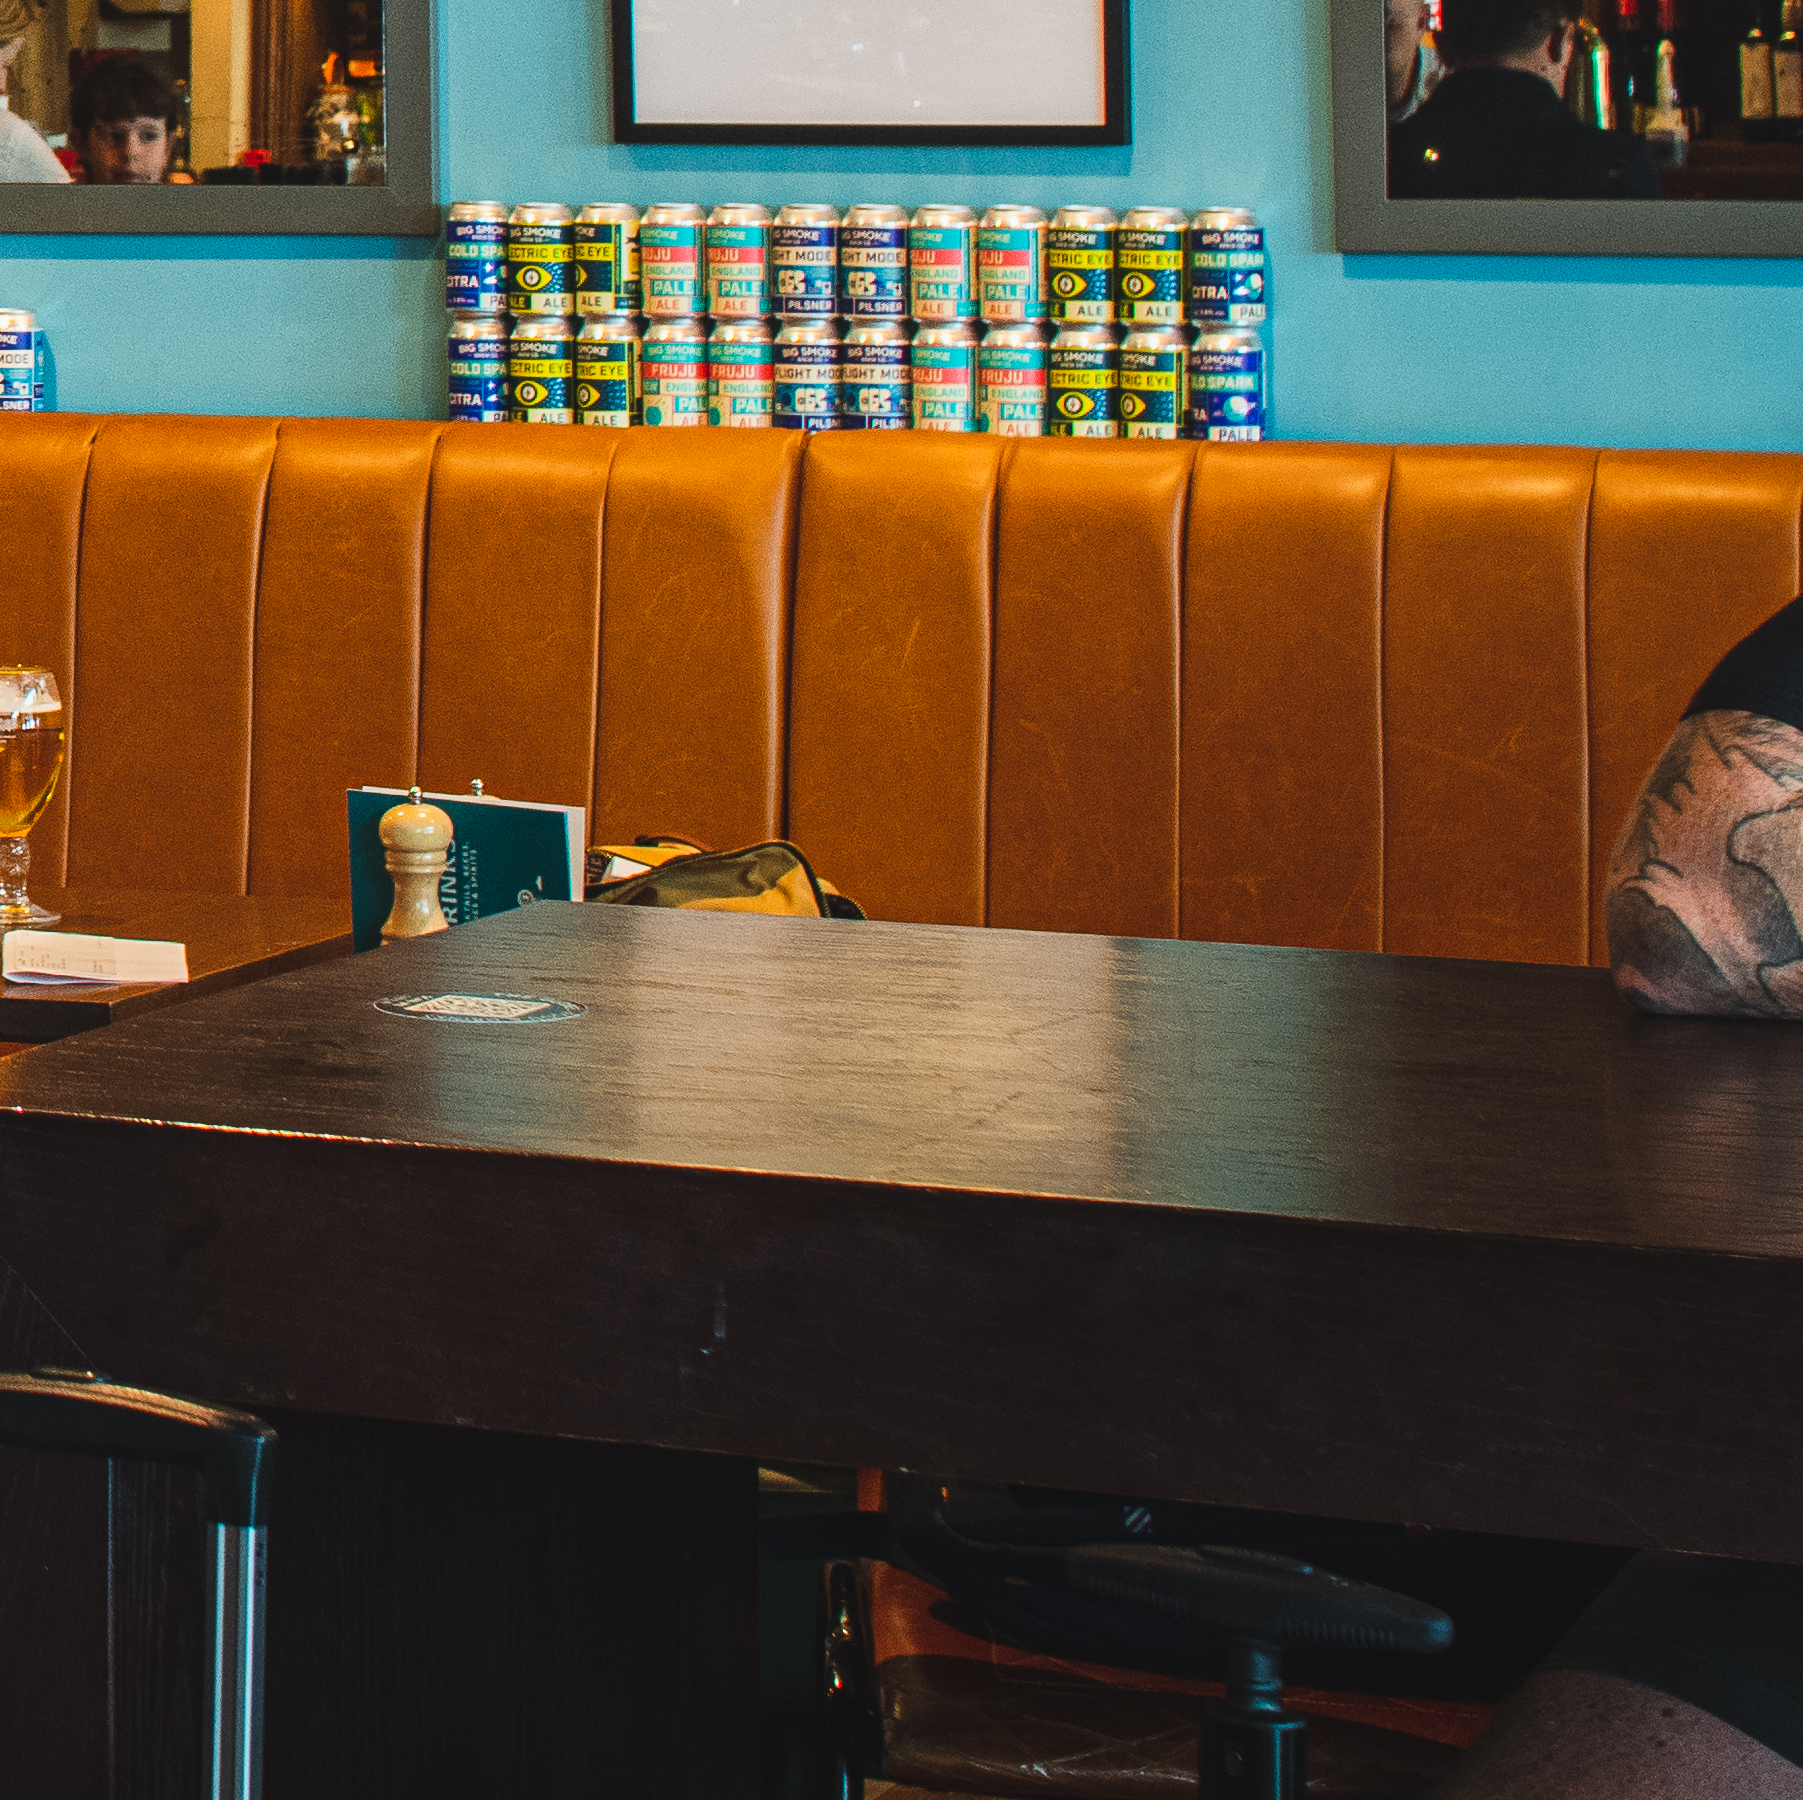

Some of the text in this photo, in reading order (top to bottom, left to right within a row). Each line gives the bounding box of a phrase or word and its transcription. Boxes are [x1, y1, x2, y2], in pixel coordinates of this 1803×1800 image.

[522, 227, 562, 239] SMOKE
[552, 248, 574, 260] EYE
[588, 245, 611, 258] EYE
[795, 250, 832, 262] MODE
[866, 252, 903, 264] MODE
[1086, 254, 1112, 266] EYE
[1156, 254, 1181, 266] EYE
[653, 280, 694, 295] PALE
[721, 281, 761, 295] PALE
[919, 285, 958, 298] PALE
[987, 285, 1026, 299] PALE
[543, 296, 567, 308] ALE
[581, 295, 602, 307] ALE
[656, 299, 680, 310] ALE
[723, 300, 748, 311] ALE
[921, 302, 944, 314] ALE
[989, 303, 1012, 315] ALE
[1077, 305, 1103, 317] ALE
[1146, 305, 1172, 317] ALE
[521, 342, 558, 354] SMOKE
[1063, 352, 1104, 364] SMOKE
[549, 362, 571, 375] EYE
[600, 364, 625, 376] EYE
[651, 364, 697, 377] FRUJU
[712, 365, 755, 378] FRUJU
[1146, 376, 1171, 388] EYE
[1208, 375, 1254, 389] SPARK
[925, 402, 966, 417] PALE
[540, 413, 565, 424] ALE
[593, 415, 617, 426] ALE
[1006, 424, 1031, 436] ALE
[1086, 424, 1113, 436] ALE
[1138, 427, 1162, 439] ALE
[1218, 427, 1255, 441] PALE
[441, 840, 458, 923] RINK
